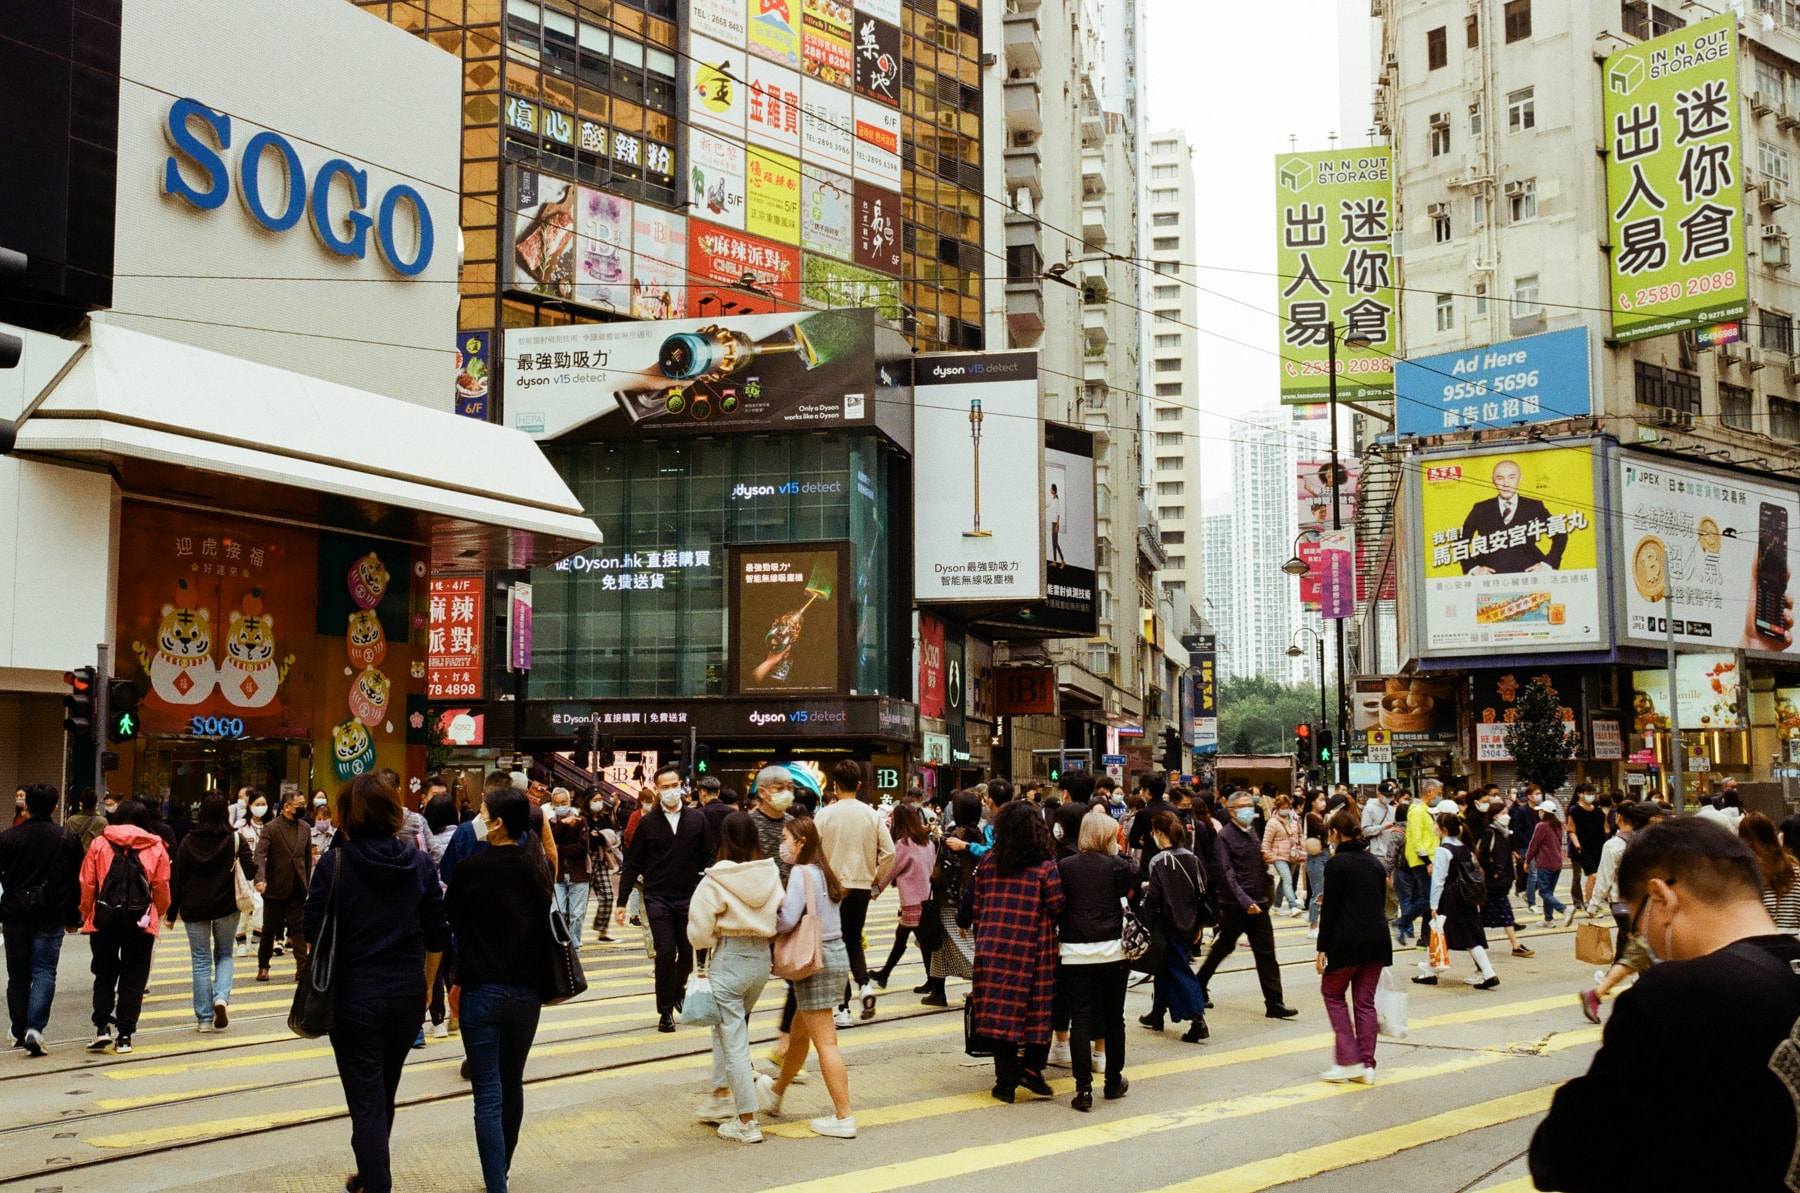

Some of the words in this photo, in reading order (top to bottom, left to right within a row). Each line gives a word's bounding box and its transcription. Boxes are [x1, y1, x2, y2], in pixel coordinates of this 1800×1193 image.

[1651, 50, 1666, 64] IN
[1675, 44, 1685, 56] N
[1694, 30, 1728, 49] OUT
[804, 44, 827, 61] 2881
[828, 54, 850, 71] 8204
[1650, 43, 1729, 79] STORAGE
[750, 79, 798, 136] 金羅寶
[884, 115, 897, 127] 6/F
[1320, 162, 1334, 172] IN
[1342, 161, 1351, 170] N
[1358, 158, 1388, 168] OUT
[1676, 81, 1734, 263] 迷你倉
[1318, 170, 1388, 184] STORAGE
[166, 97, 434, 276] SOGO
[1616, 105, 1666, 274] 出入易
[520, 195, 532, 204] 3F
[727, 193, 743, 207] 5/F
[784, 200, 798, 214] 5/F
[713, 235, 781, 271] 麻辣派對
[1284, 204, 1330, 346] 出入易
[1341, 198, 1390, 343] 迷你倉
[1636, 283, 1681, 306] 2580
[1688, 271, 1736, 296] 2088
[1708, 311, 1726, 320] 9275
[933, 365, 965, 378] dyson
[968, 364, 985, 374] v15
[986, 362, 1018, 374] detect
[1302, 361, 1344, 375] 2580
[1350, 358, 1390, 373] 2088
[1452, 358, 1478, 376] Ad
[1483, 350, 1527, 370] Here
[516, 376, 550, 389] dyson
[553, 374, 571, 384] v15
[572, 372, 607, 384] detect
[1442, 379, 1488, 402] 9556
[1493, 370, 1540, 393] 5696
[465, 403, 483, 415] 6/F
[798, 404, 815, 412] Only
[820, 404, 840, 412] Dyson
[820, 412, 840, 420] Dyson
[1443, 395, 1541, 428] 廣告位招租
[518, 415, 543, 425] HEPA
[1638, 472, 1660, 486] JPEX
[779, 482, 800, 495] v15
[802, 480, 841, 494] detect
[1432, 510, 1588, 568] 馬百良安宮牛黃丸
[176, 536, 265, 568] 迎虎接福
[647, 551, 710, 568] 直接購買
[934, 563, 966, 574] Dyson
[452, 580, 470, 590] 4/F
[602, 574, 665, 590] 免費送貨
[746, 574, 804, 584] 智能無線吸塵機
[941, 572, 1014, 586] 智能無線吸塵機
[430, 596, 474, 624] 麻辣
[445, 684, 476, 694] 4898
[1202, 660, 1213, 710] IKEA
[192, 716, 244, 736] SOGO
[604, 713, 640, 723] 直接購買
[650, 713, 688, 722] 免費送貨
[750, 710, 786, 726] dyson
[790, 711, 809, 722] v15
[810, 711, 846, 722] detect
[1480, 750, 1500, 758] 3104
[612, 767, 628, 781] iB
[876, 769, 898, 788] iB
